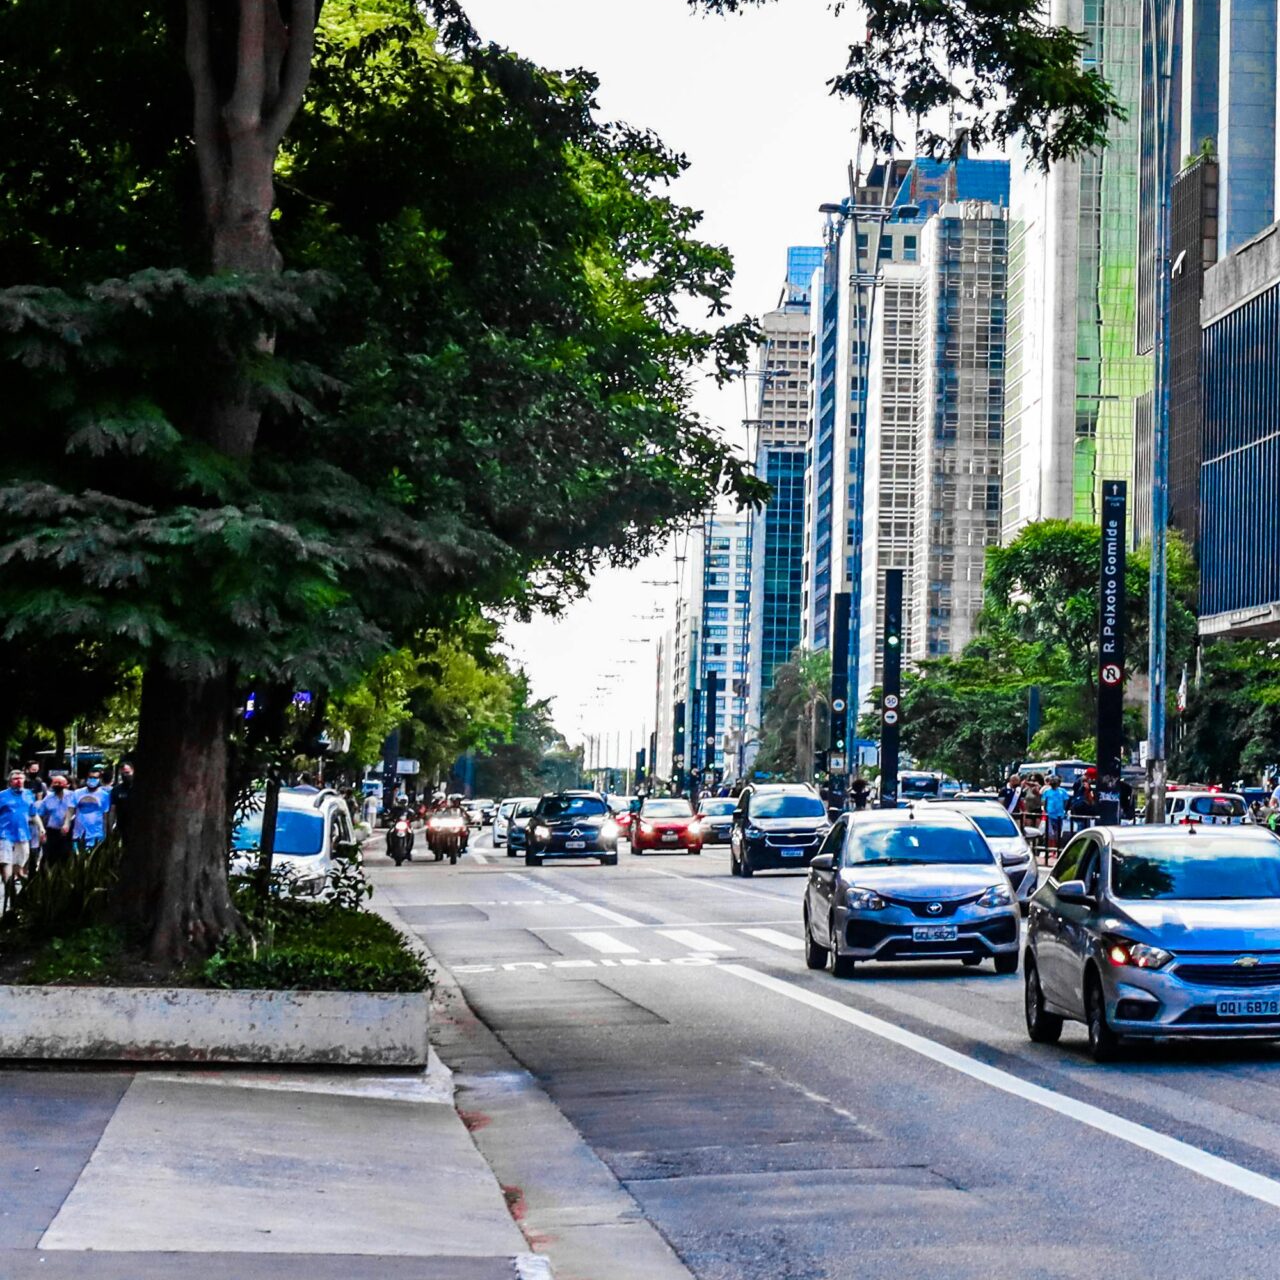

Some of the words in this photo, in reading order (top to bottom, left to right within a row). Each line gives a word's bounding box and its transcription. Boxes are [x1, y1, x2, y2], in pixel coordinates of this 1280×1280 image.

[1105, 520, 1118, 576] Gomide
[1103, 580, 1117, 636] Peixoto
[1103, 640, 1115, 653] R.
